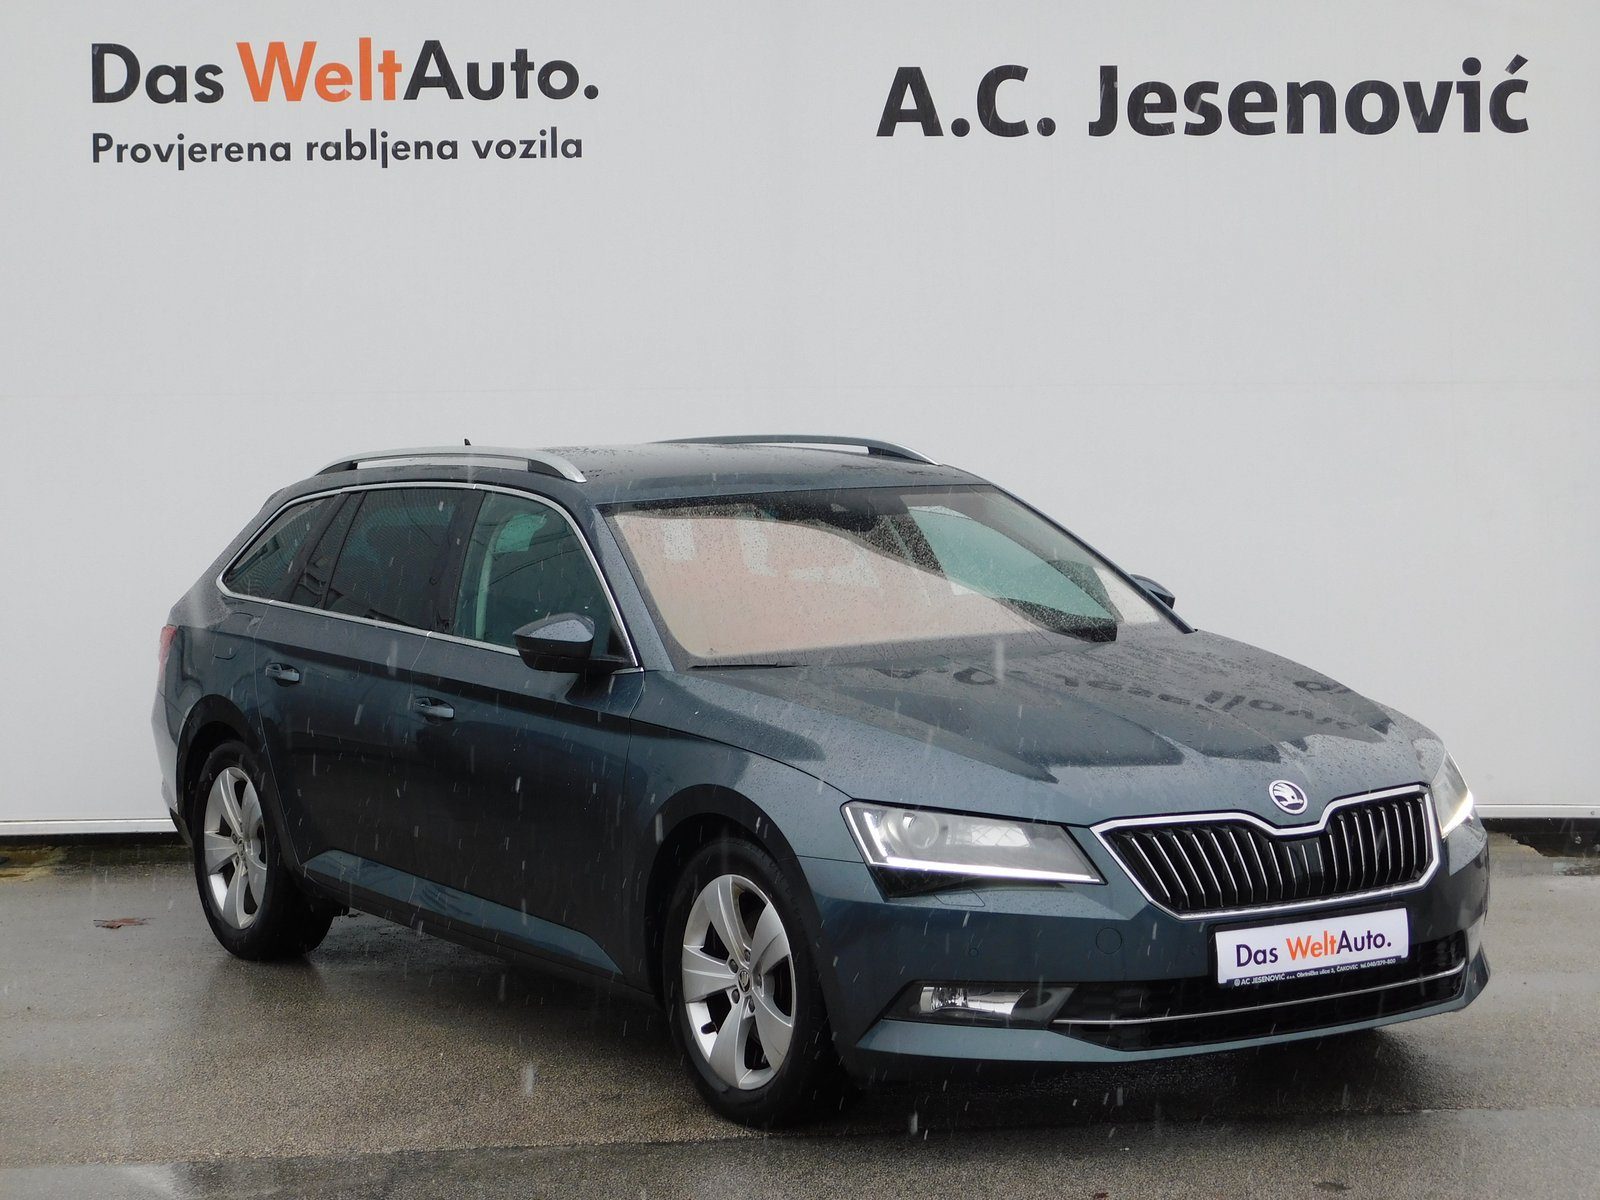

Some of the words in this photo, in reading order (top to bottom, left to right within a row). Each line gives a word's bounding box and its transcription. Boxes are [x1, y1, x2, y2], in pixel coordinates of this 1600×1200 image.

[91, 43, 225, 105] Das
[236, 38, 600, 105] WeltAuto.
[876, 64, 1057, 138] A.C.
[1088, 53, 1530, 138] Jesenović
[91, 131, 291, 171] Provjerena
[305, 127, 460, 169] rabljena
[471, 126, 584, 161] vozila
[1236, 943, 1279, 967] Das
[1286, 929, 1393, 961] WeltAuto.
